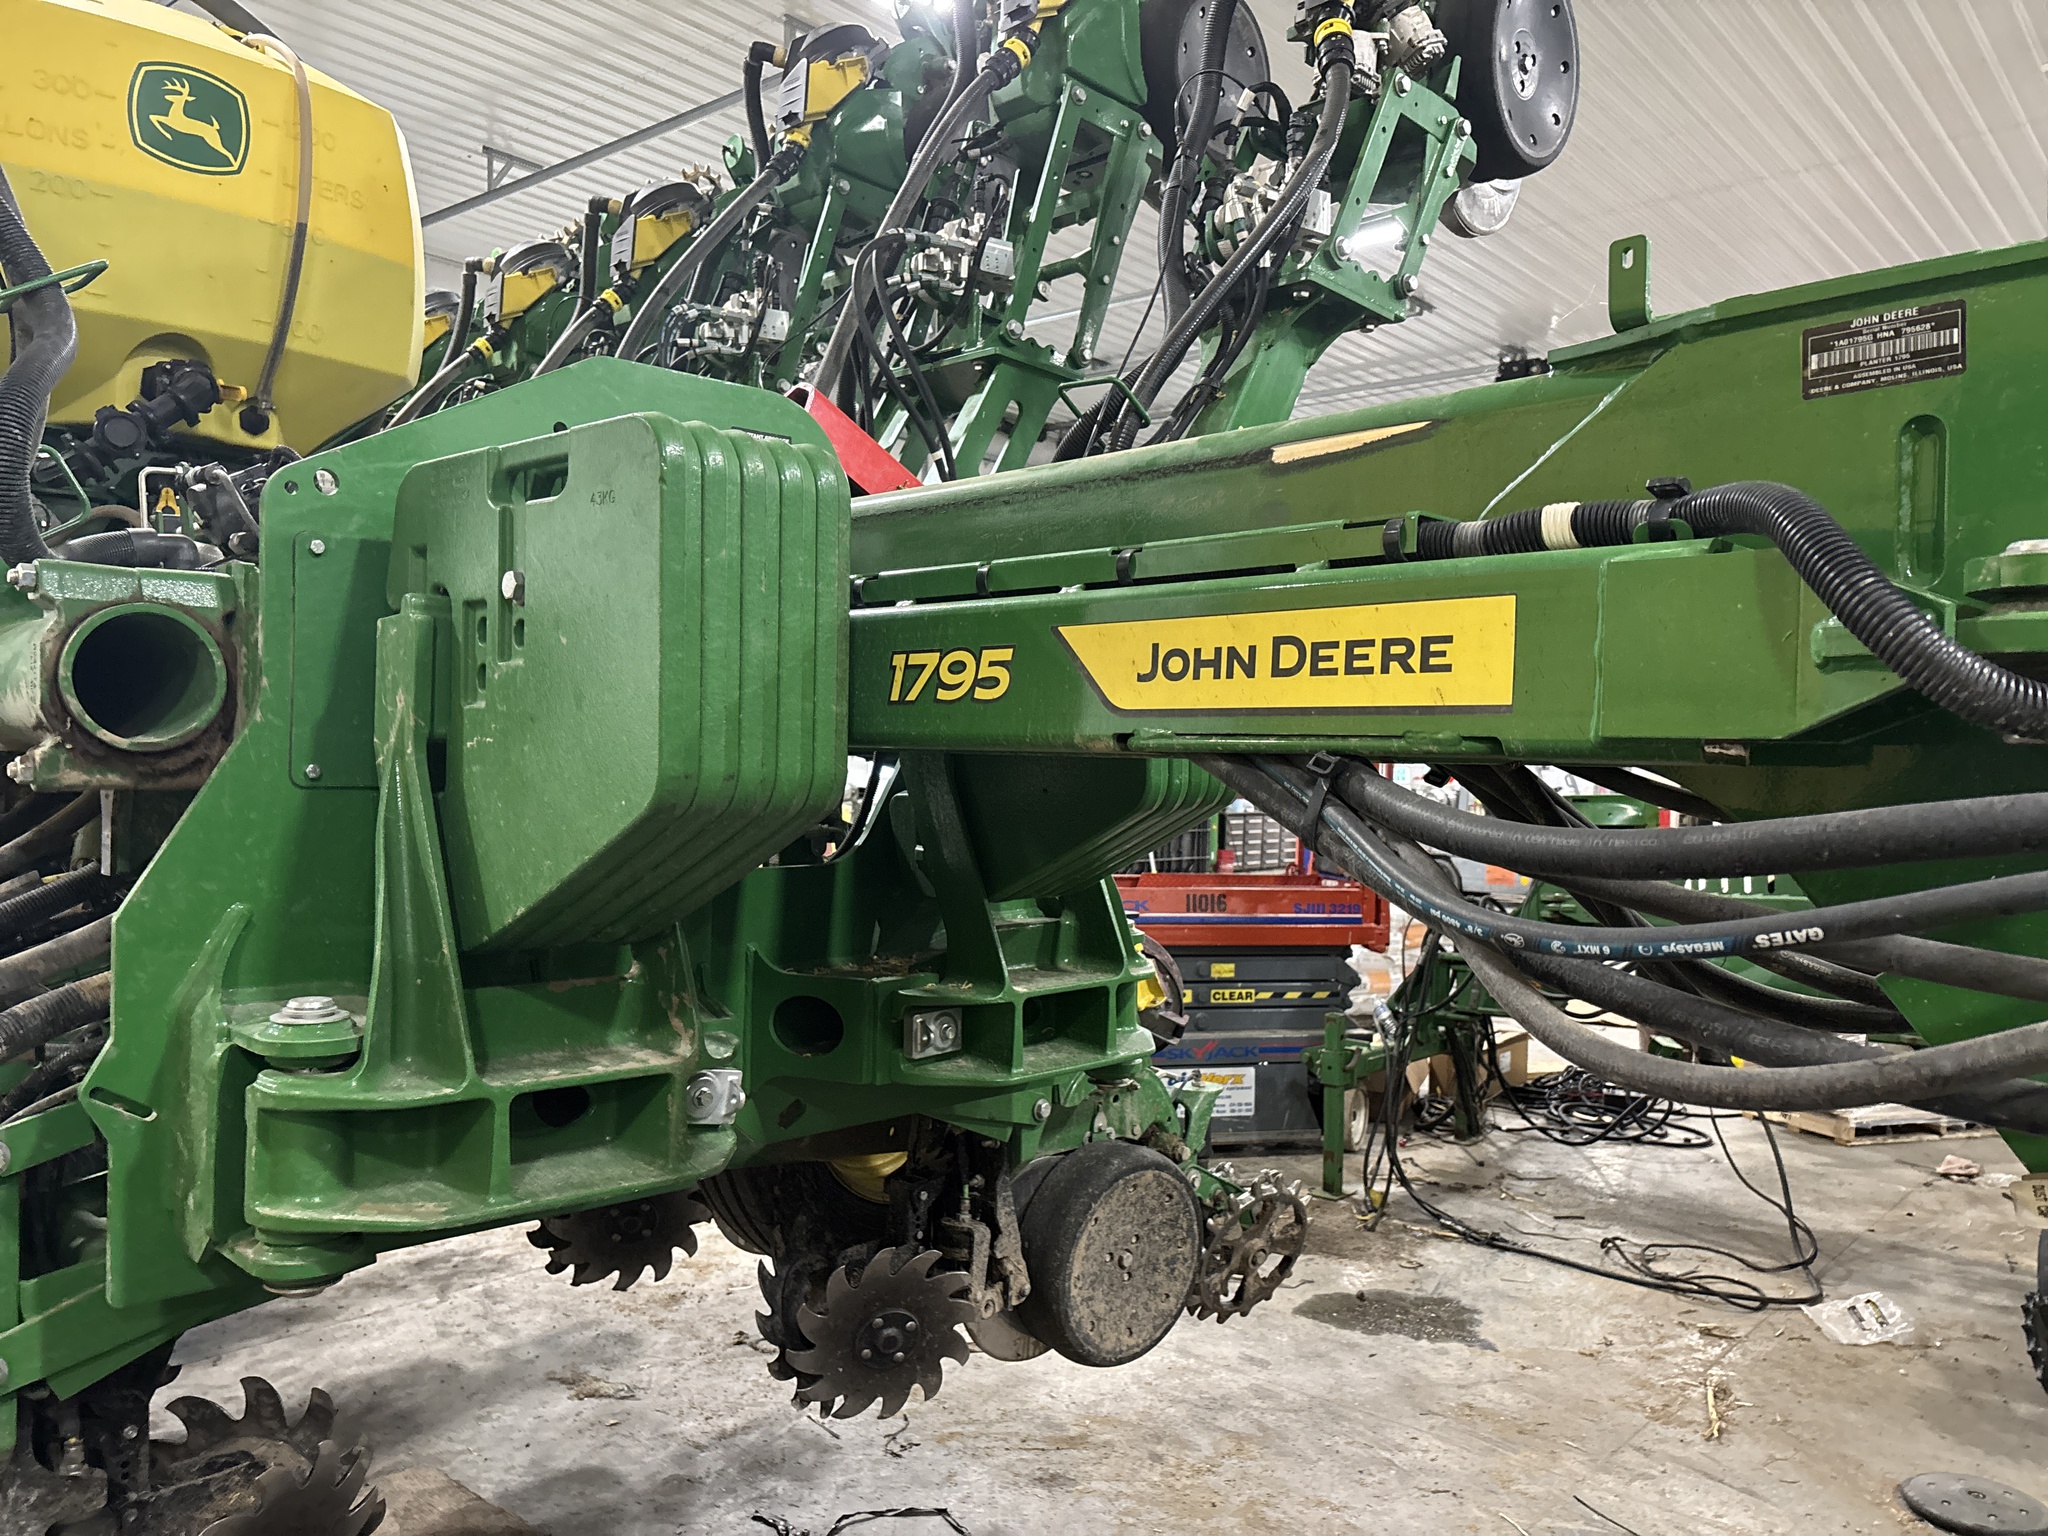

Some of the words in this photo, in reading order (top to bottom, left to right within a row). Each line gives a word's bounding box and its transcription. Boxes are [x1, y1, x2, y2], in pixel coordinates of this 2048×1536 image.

[1850, 314, 1880, 329] JOHN
[1883, 306, 1919, 322] DEERE
[1876, 329, 1896, 339] HNA
[1859, 356, 1892, 368] PLANTER
[1947, 362, 1964, 371] USA
[1852, 368, 1892, 380] ASSEMBLED
[1902, 363, 1917, 371] USA
[1136, 642, 1258, 683] JOHN
[1270, 634, 1455, 679] DEERE
[889, 647, 1014, 703] 1795
[1186, 893, 1227, 913] 11016
[1329, 903, 1362, 915] 3219
[1754, 926, 1825, 948] GATES
[1576, 943, 1600, 955] MXT
[1602, 944, 1612, 956] 6
[1212, 991, 1253, 1001] CLEAR
[1167, 1040, 1258, 1060] SKYJACK
